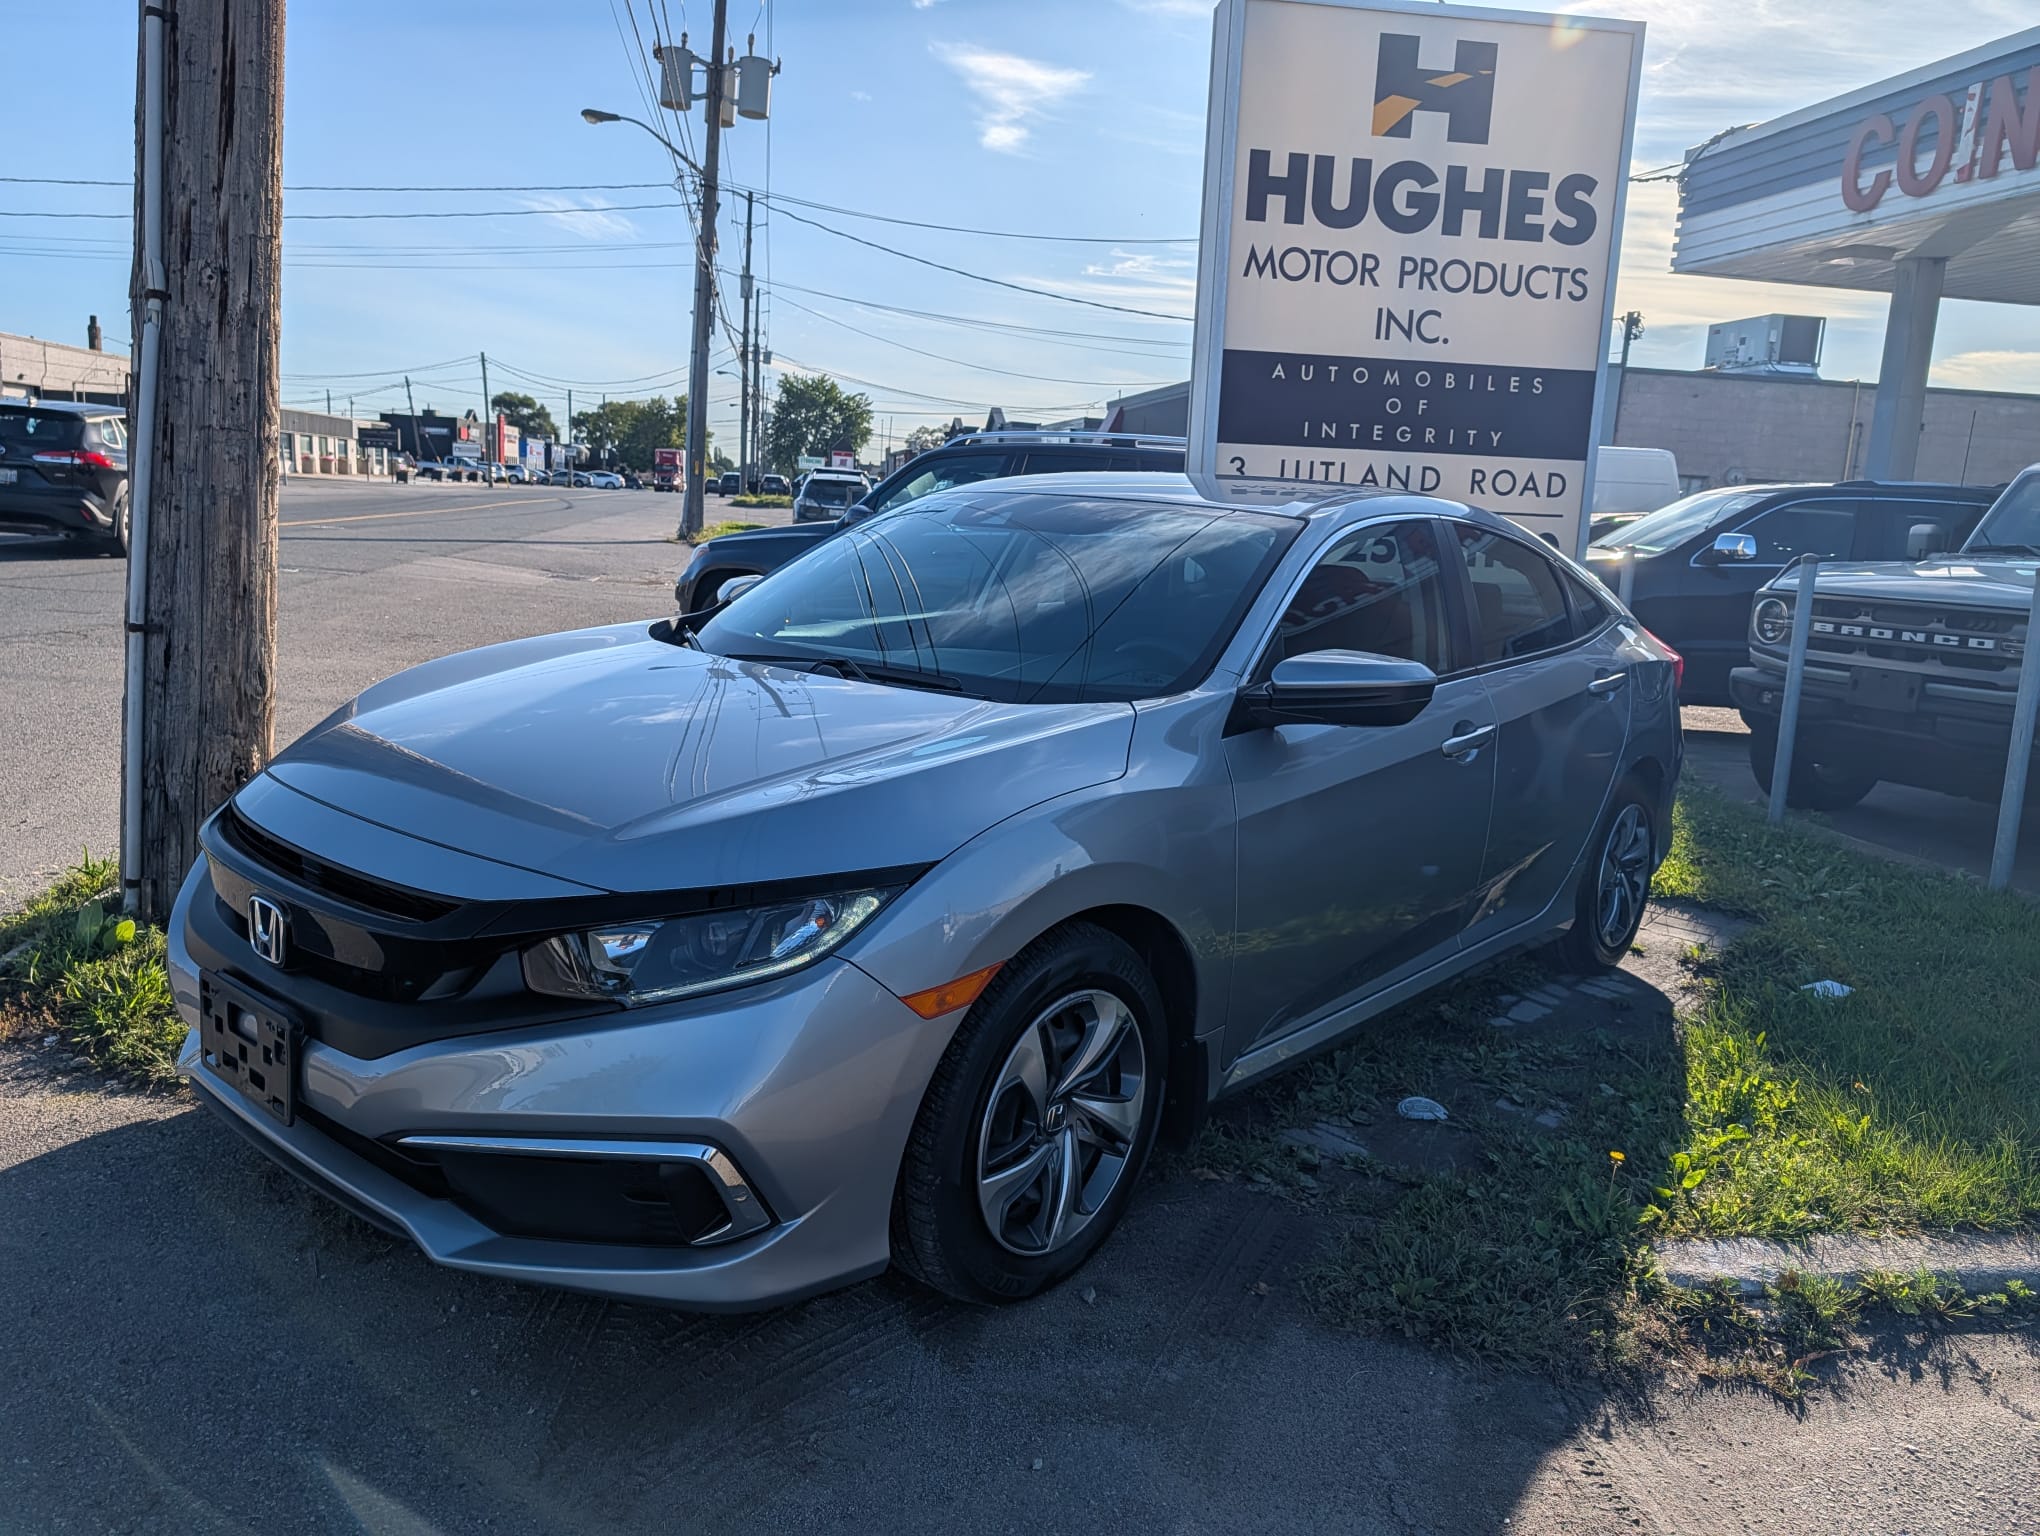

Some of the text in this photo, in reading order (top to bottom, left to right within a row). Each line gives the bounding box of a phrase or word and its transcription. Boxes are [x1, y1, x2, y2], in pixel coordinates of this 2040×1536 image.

[1245, 149, 1599, 246] HUGHES
[1243, 244, 1589, 302] MOTOR PRODUCTS
[1375, 307, 1450, 345] INC.
[1271, 363, 1545, 394] AUTOMOBILES
[1385, 397, 1428, 416] OF
[1303, 421, 1504, 448] INTEGRITY
[1470, 469, 1567, 498] ROAD
[1813, 622, 1995, 649] BRONCO
